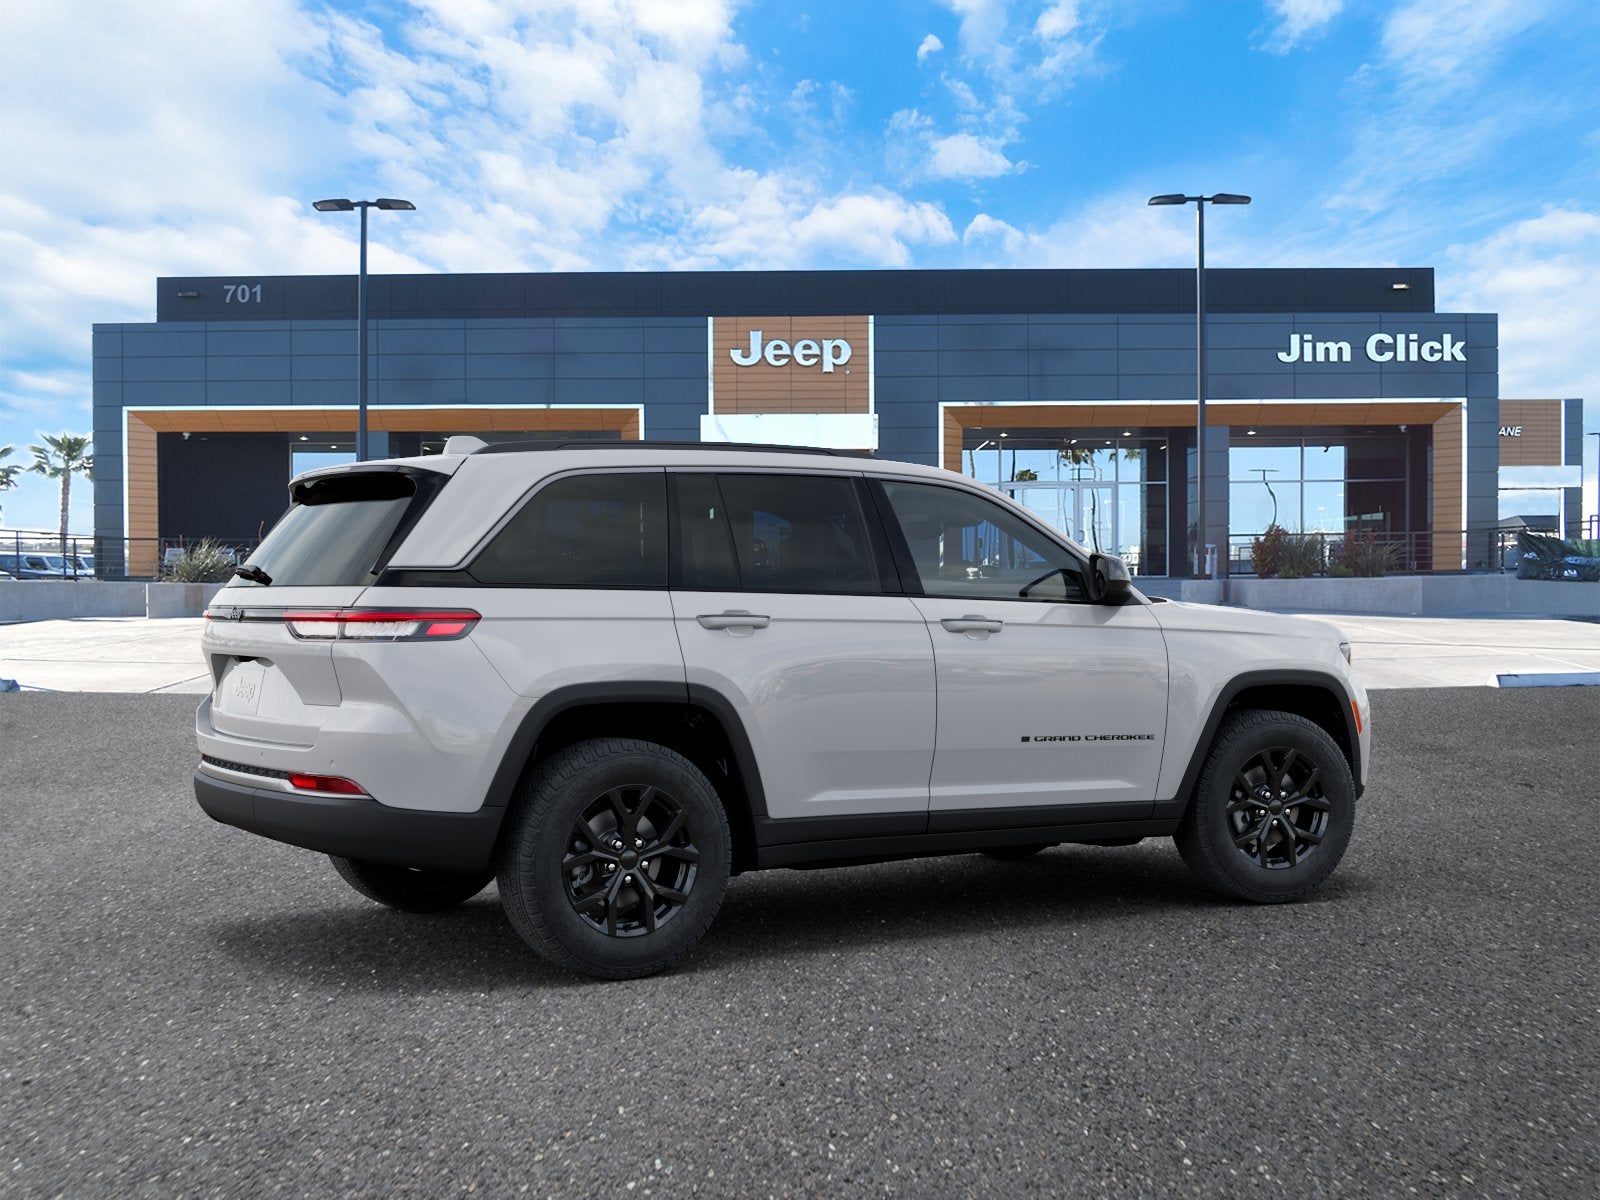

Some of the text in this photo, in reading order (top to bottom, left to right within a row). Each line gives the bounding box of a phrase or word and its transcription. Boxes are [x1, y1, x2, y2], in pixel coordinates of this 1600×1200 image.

[223, 284, 262, 304] 701
[730, 329, 852, 373] Jeep
[1277, 333, 1467, 363] Jim Click
